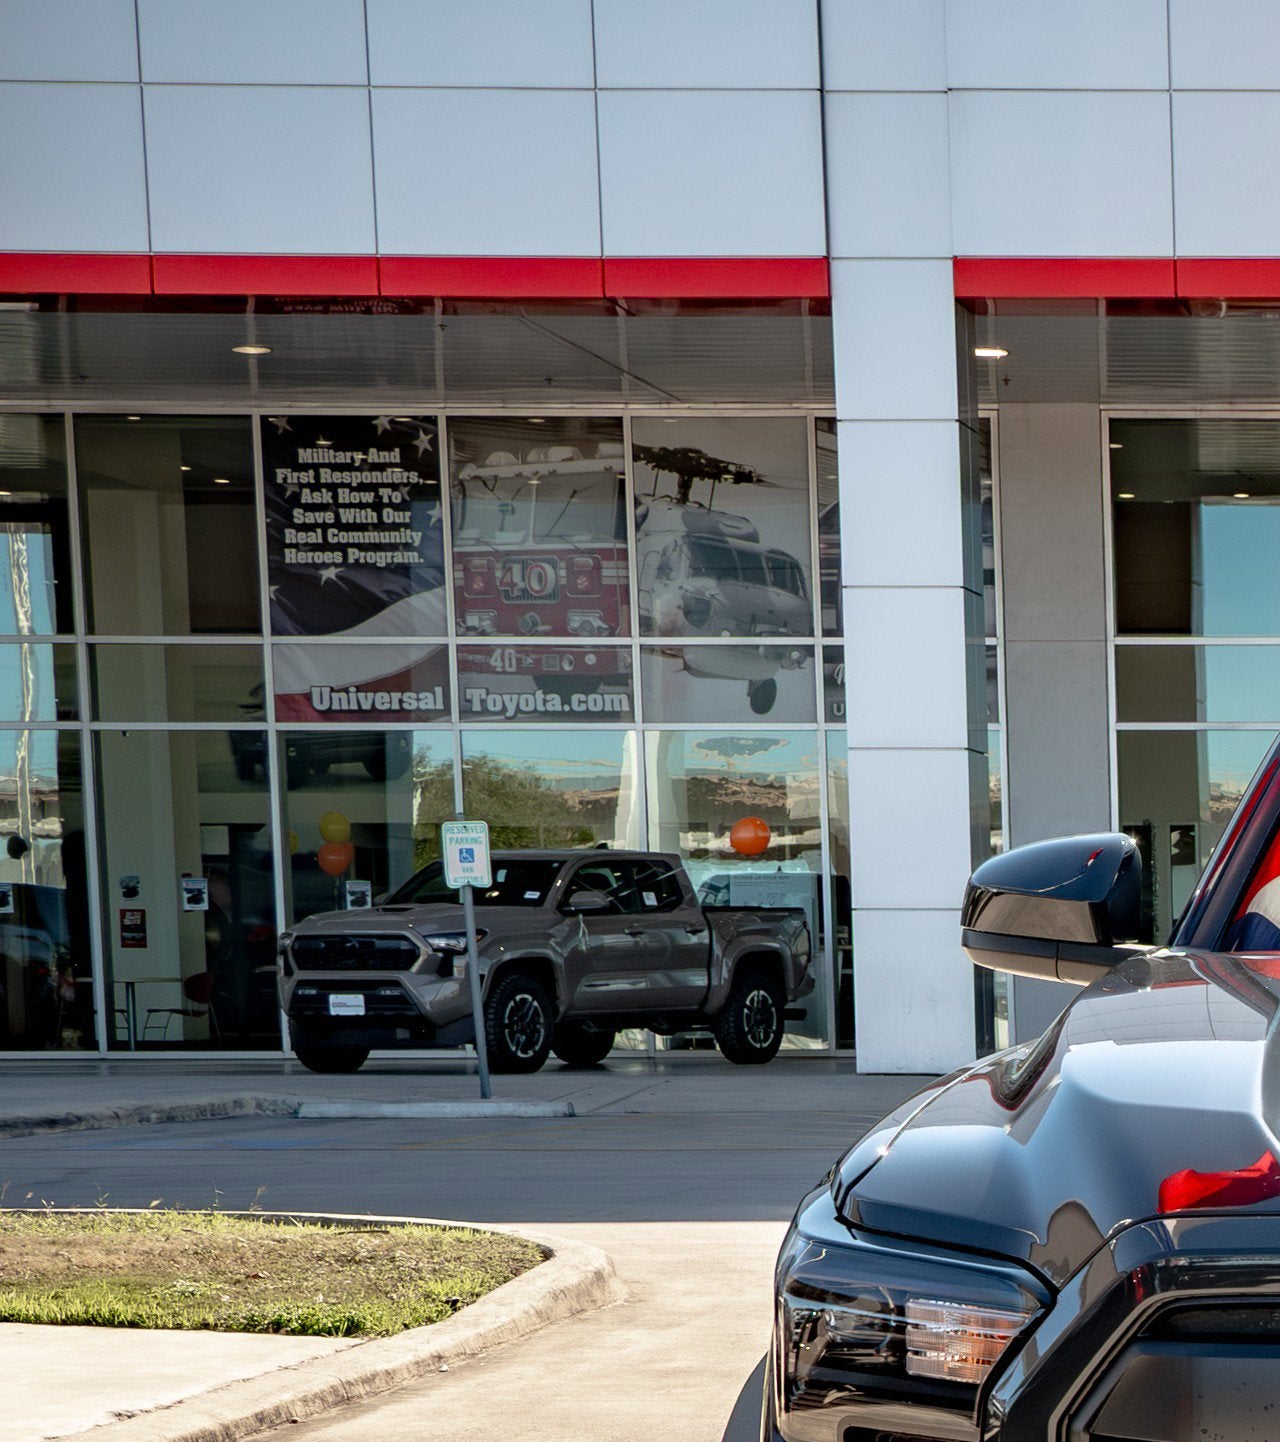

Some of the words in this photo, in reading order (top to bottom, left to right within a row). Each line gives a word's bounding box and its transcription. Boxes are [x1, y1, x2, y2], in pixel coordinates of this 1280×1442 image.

[298, 446, 363, 466] Military
[367, 446, 400, 463] And
[276, 467, 316, 484] First
[319, 467, 424, 487] Responders,
[300, 487, 333, 504] Ask
[336, 487, 374, 504] How
[378, 488, 403, 504] To
[292, 507, 335, 524] Save
[338, 507, 378, 524] With
[381, 508, 412, 524] Our
[284, 528, 324, 544] Real
[327, 528, 423, 548] Community
[284, 548, 344, 565] Heroes
[347, 548, 424, 567] Program.
[498, 560, 557, 598] 40
[489, 649, 518, 673] 40
[310, 685, 445, 712] Universal
[464, 687, 630, 718] Toyota.com
[446, 825, 485, 834] RESERVED
[449, 836, 483, 846] PARKING
